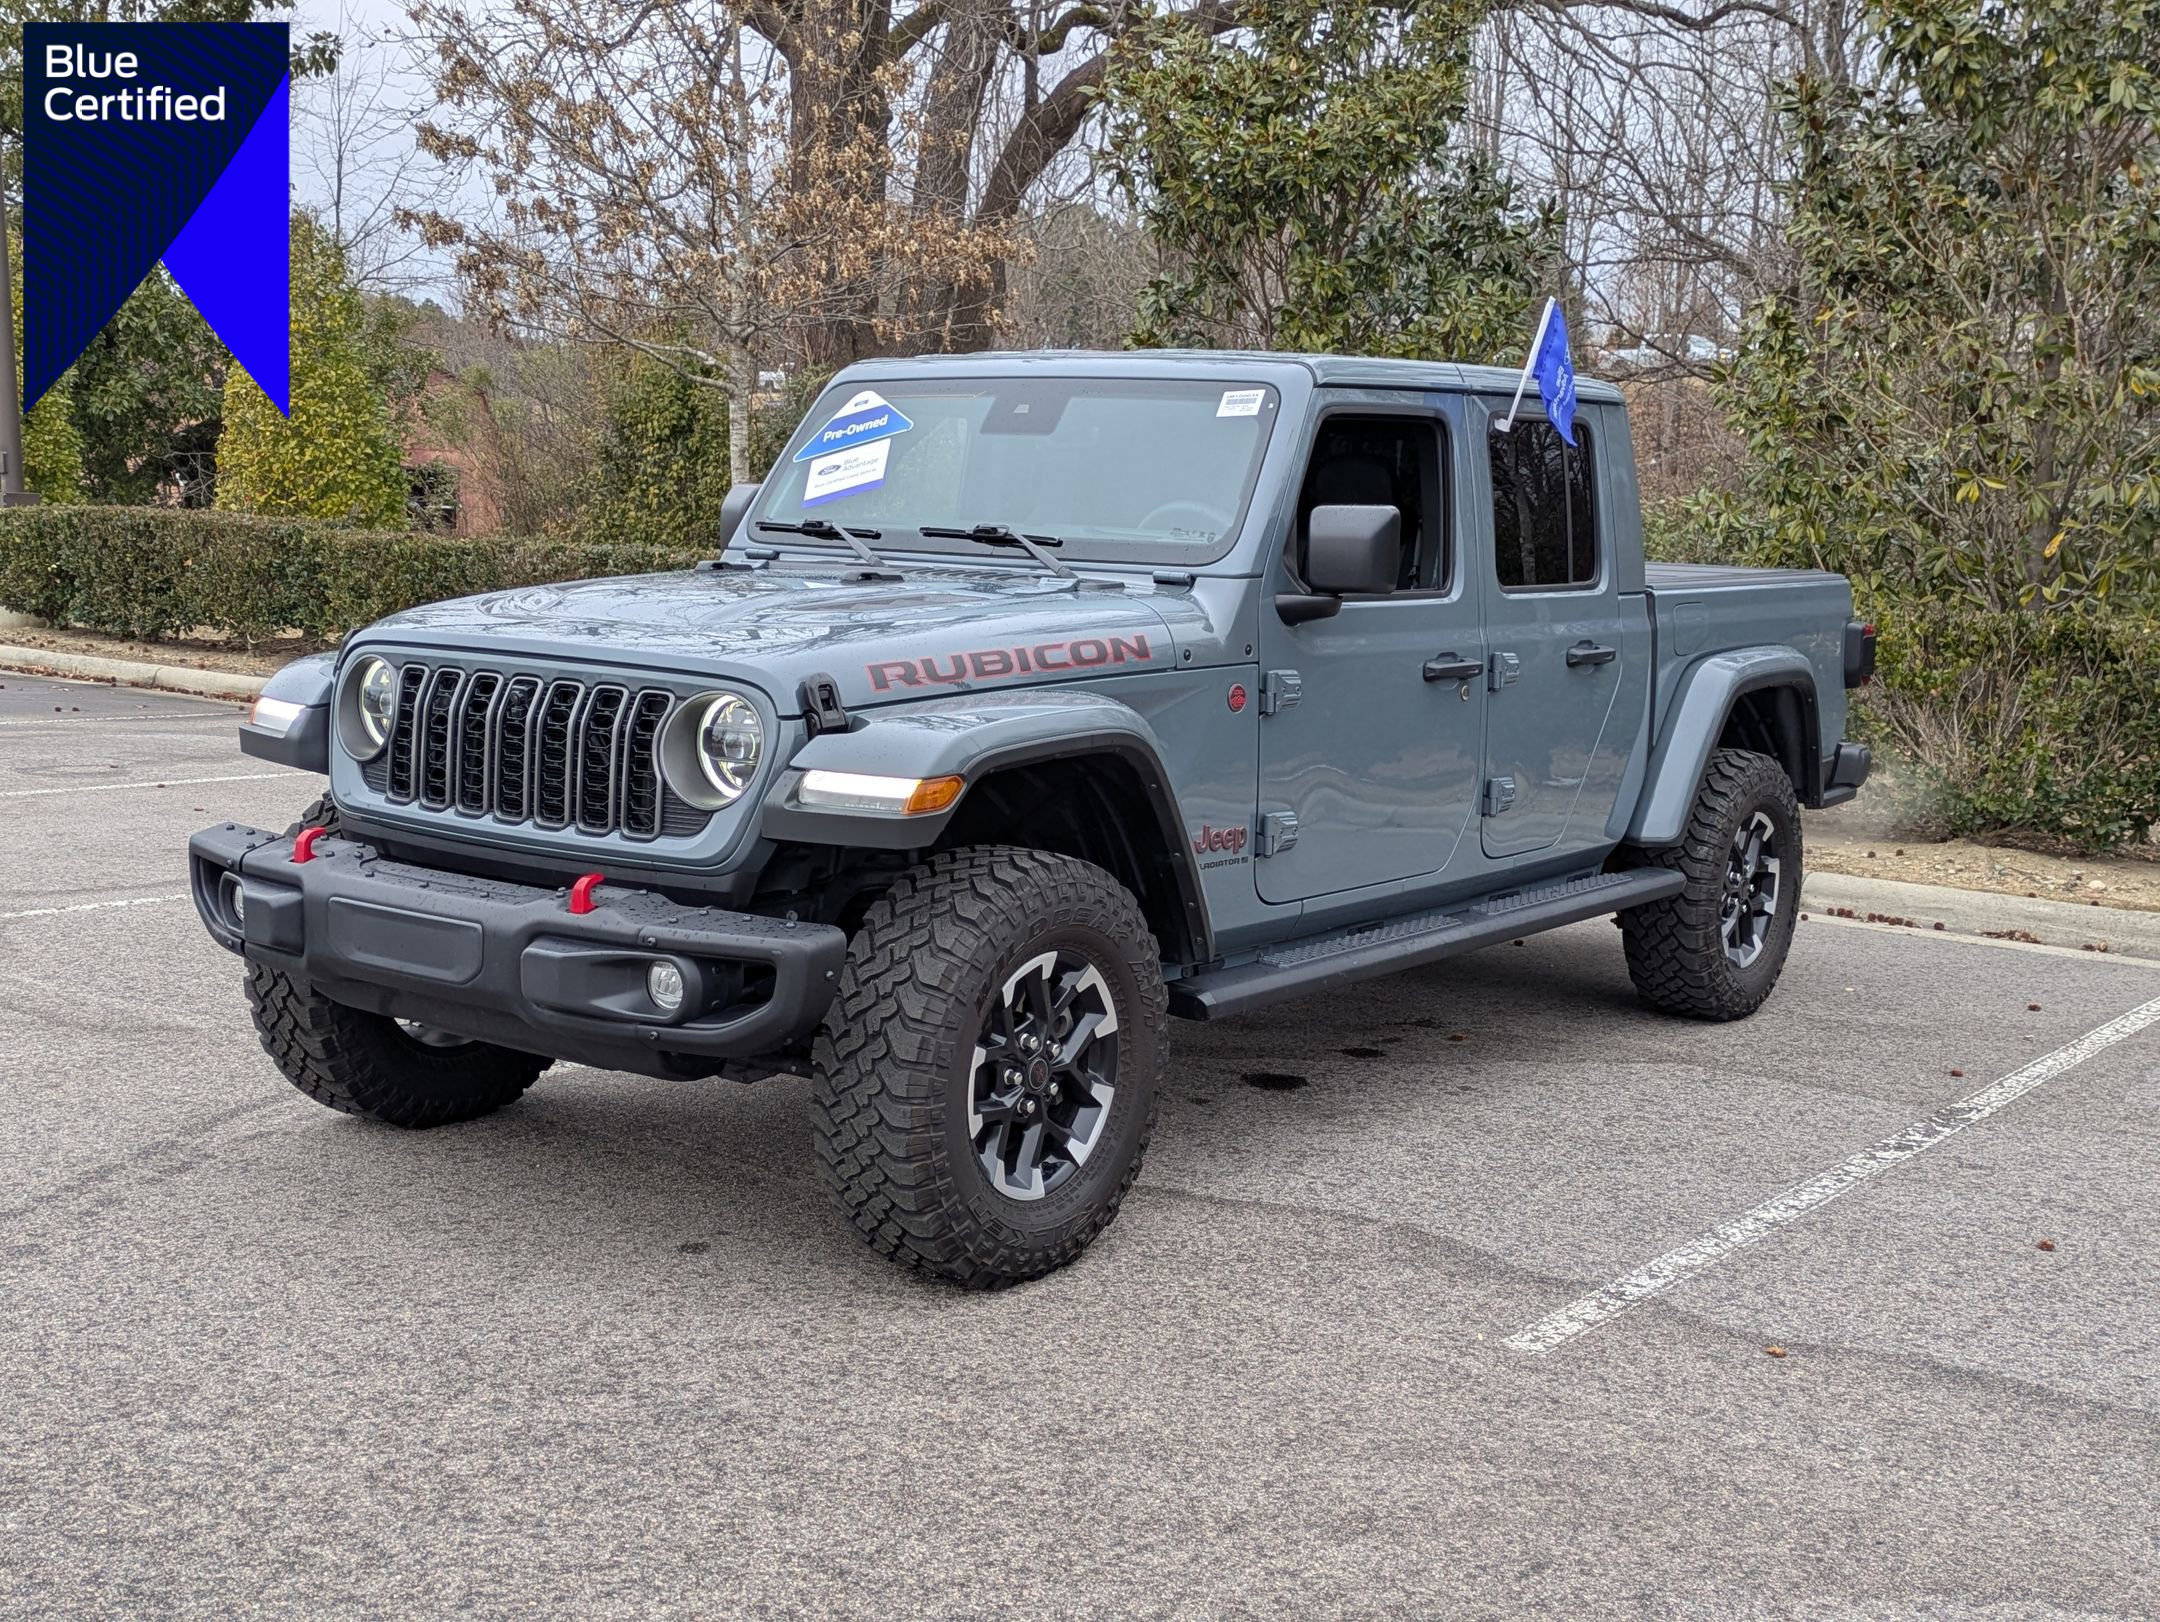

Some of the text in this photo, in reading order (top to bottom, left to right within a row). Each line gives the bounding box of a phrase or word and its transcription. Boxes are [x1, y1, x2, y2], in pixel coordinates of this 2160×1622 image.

[823, 414, 889, 443] Pre-Owned
[865, 634, 1153, 694] RUBICON
[1194, 824, 1248, 855] Jeep
[1199, 857, 1240, 870] LADIATOR
